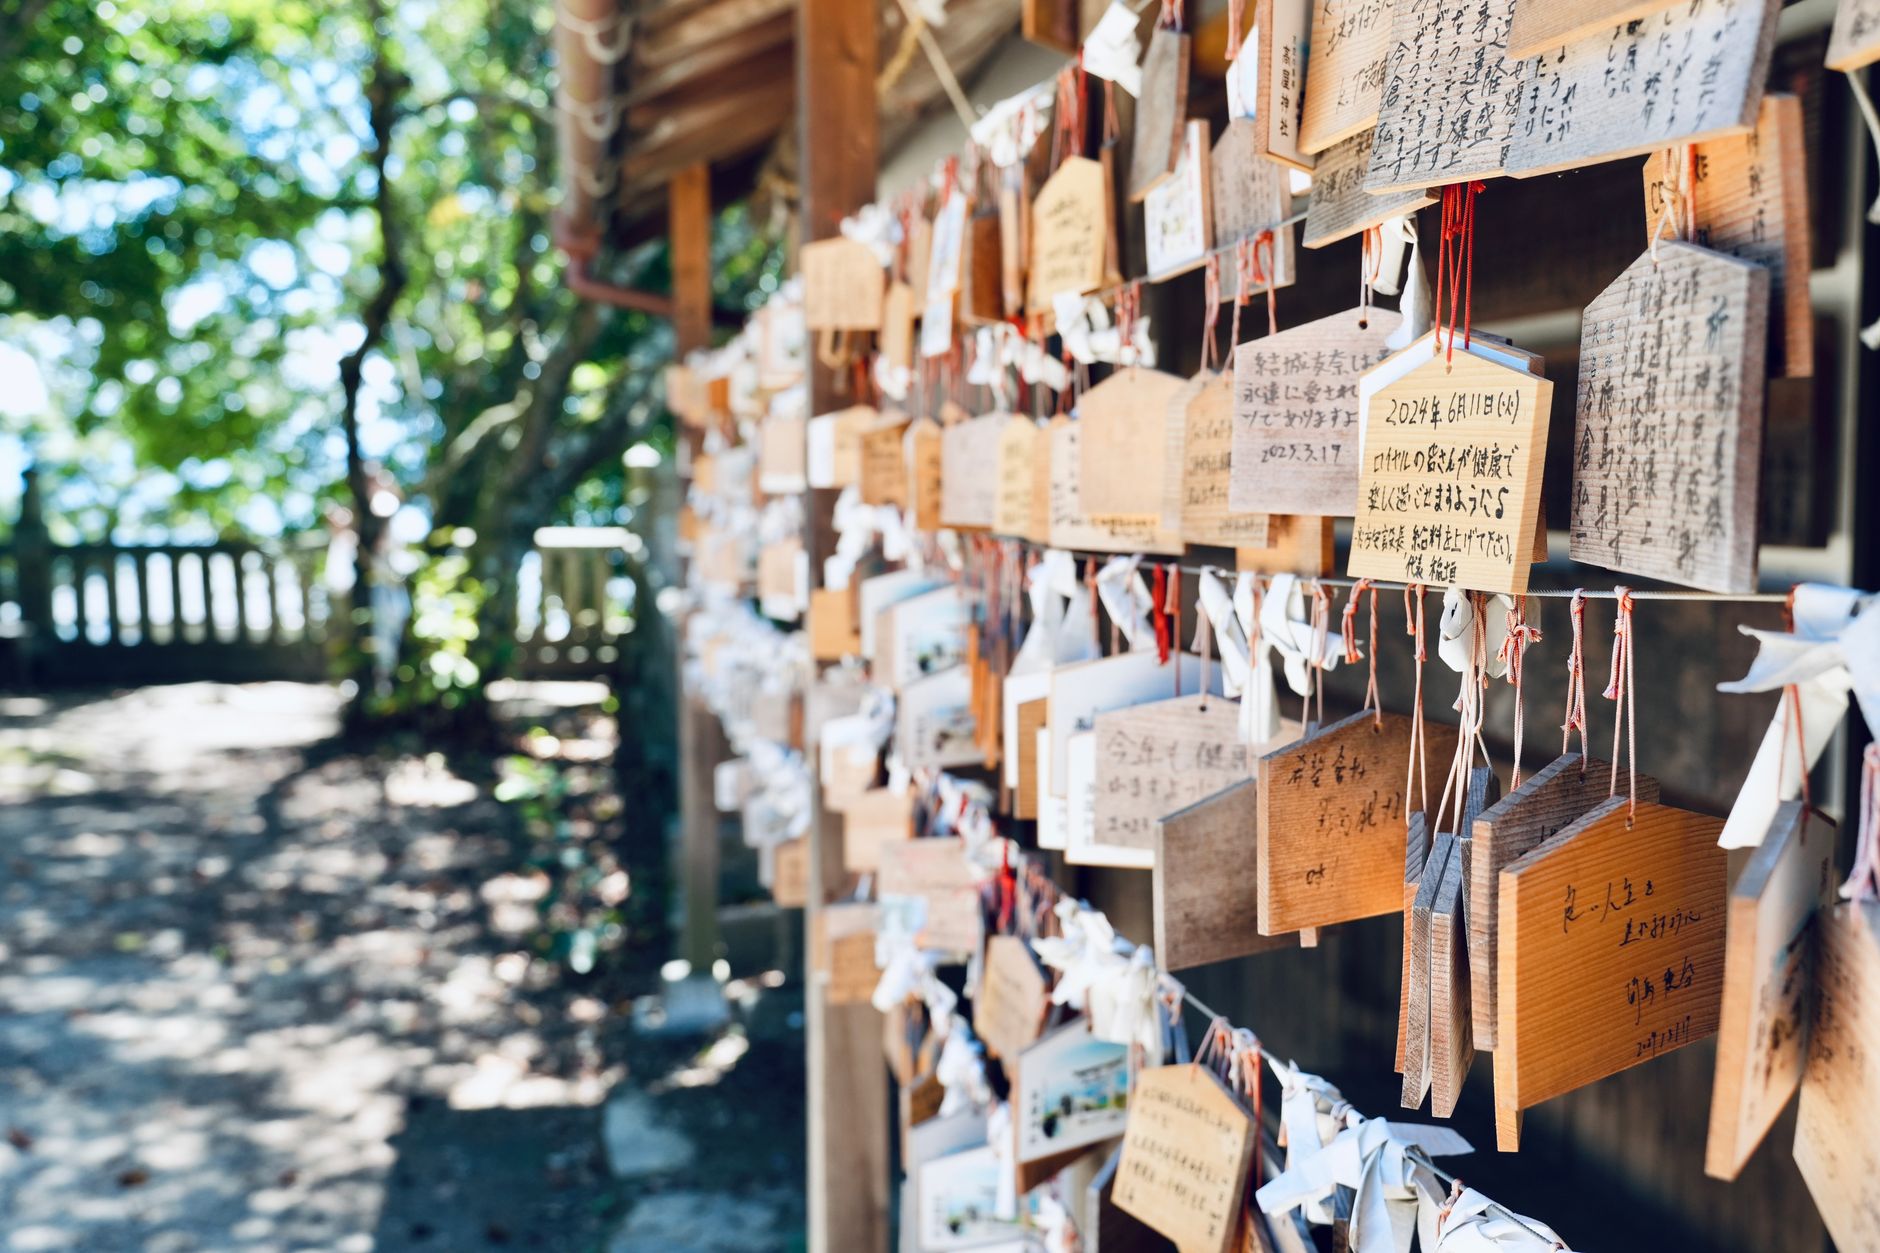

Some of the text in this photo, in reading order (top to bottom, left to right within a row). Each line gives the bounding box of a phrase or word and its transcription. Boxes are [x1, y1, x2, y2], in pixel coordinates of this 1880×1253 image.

[1373, 442, 1519, 480] ロイヤルの皆さんが健康で
